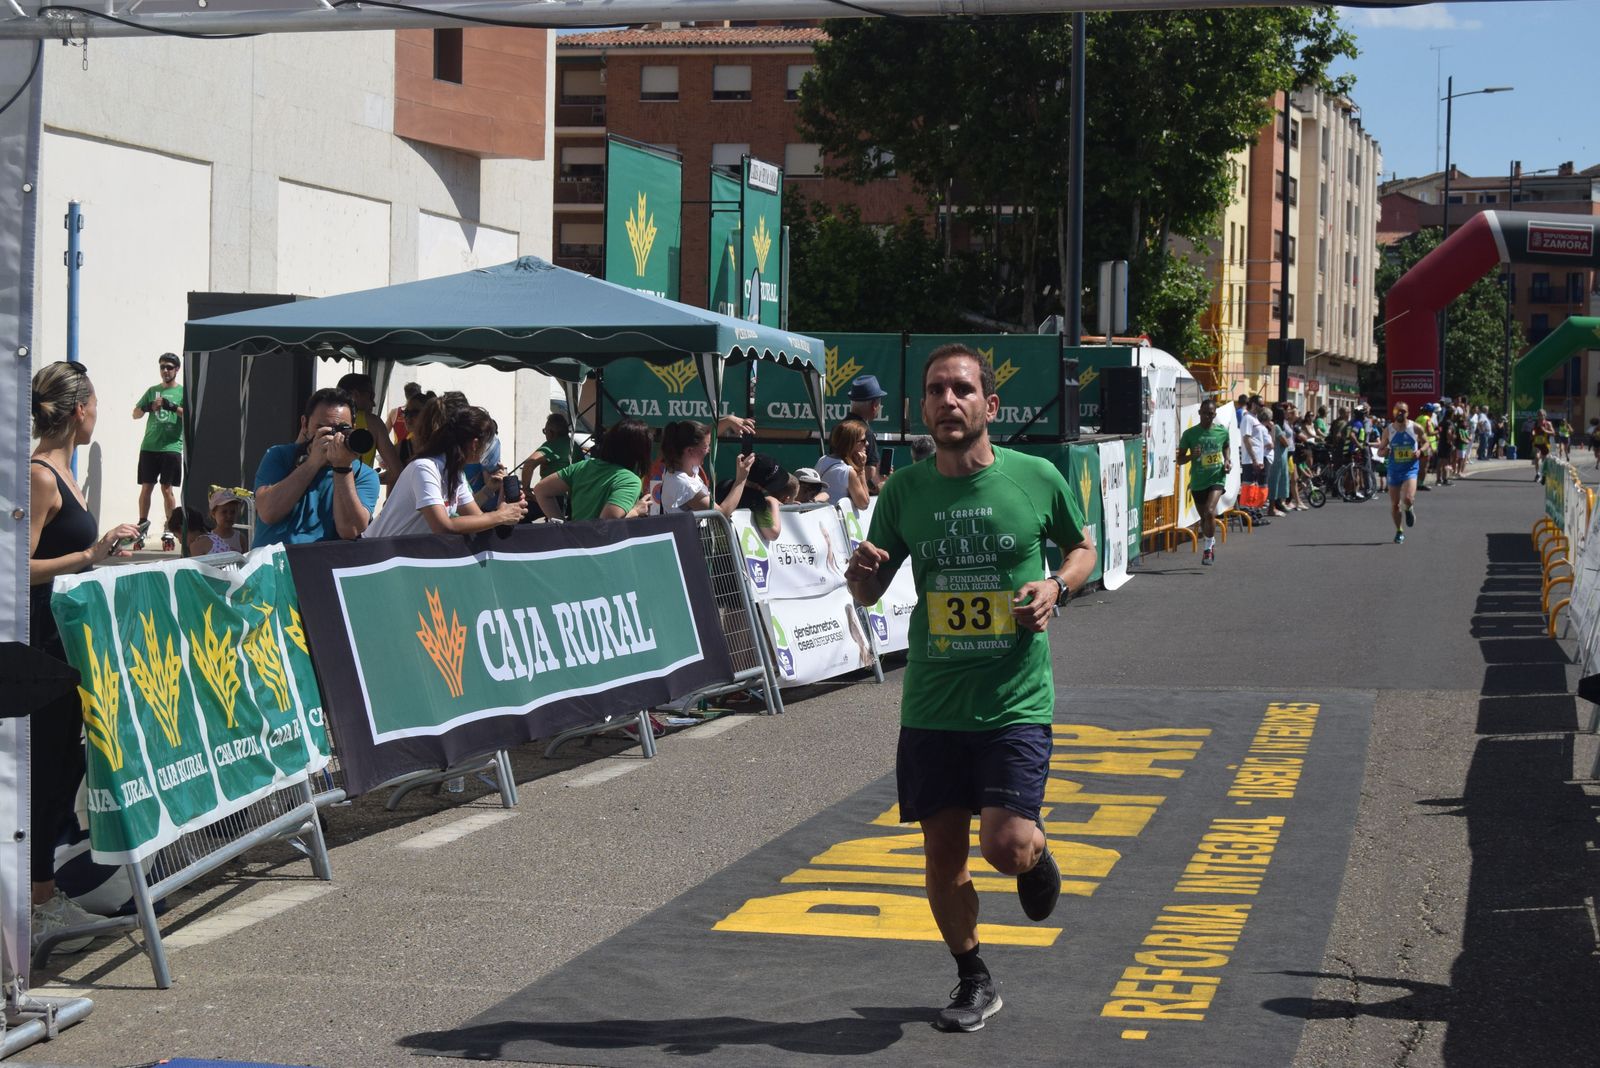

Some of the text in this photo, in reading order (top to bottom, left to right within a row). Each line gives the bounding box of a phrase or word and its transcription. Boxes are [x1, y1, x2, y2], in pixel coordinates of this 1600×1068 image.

[1543, 239, 1589, 250] ZAMORA
[1400, 382, 1433, 390] ZAMORA
[668, 400, 735, 417] RURL
[767, 402, 889, 421] CAJA RUL
[994, 405, 1048, 423] URAL
[934, 507, 993, 520] VII CARRERA
[937, 554, 998, 566] DE ZAMORA
[949, 582, 1001, 591] CAJA RURAL
[947, 597, 992, 630] 33
[476, 590, 657, 682] CAJA RURAL
[952, 640, 1011, 650] CAJA RURAL
[174, 752, 208, 784] RURAL
[87, 787, 121, 814] AJA
[1100, 815, 1287, 1022] REFORMA INTEGRAL
